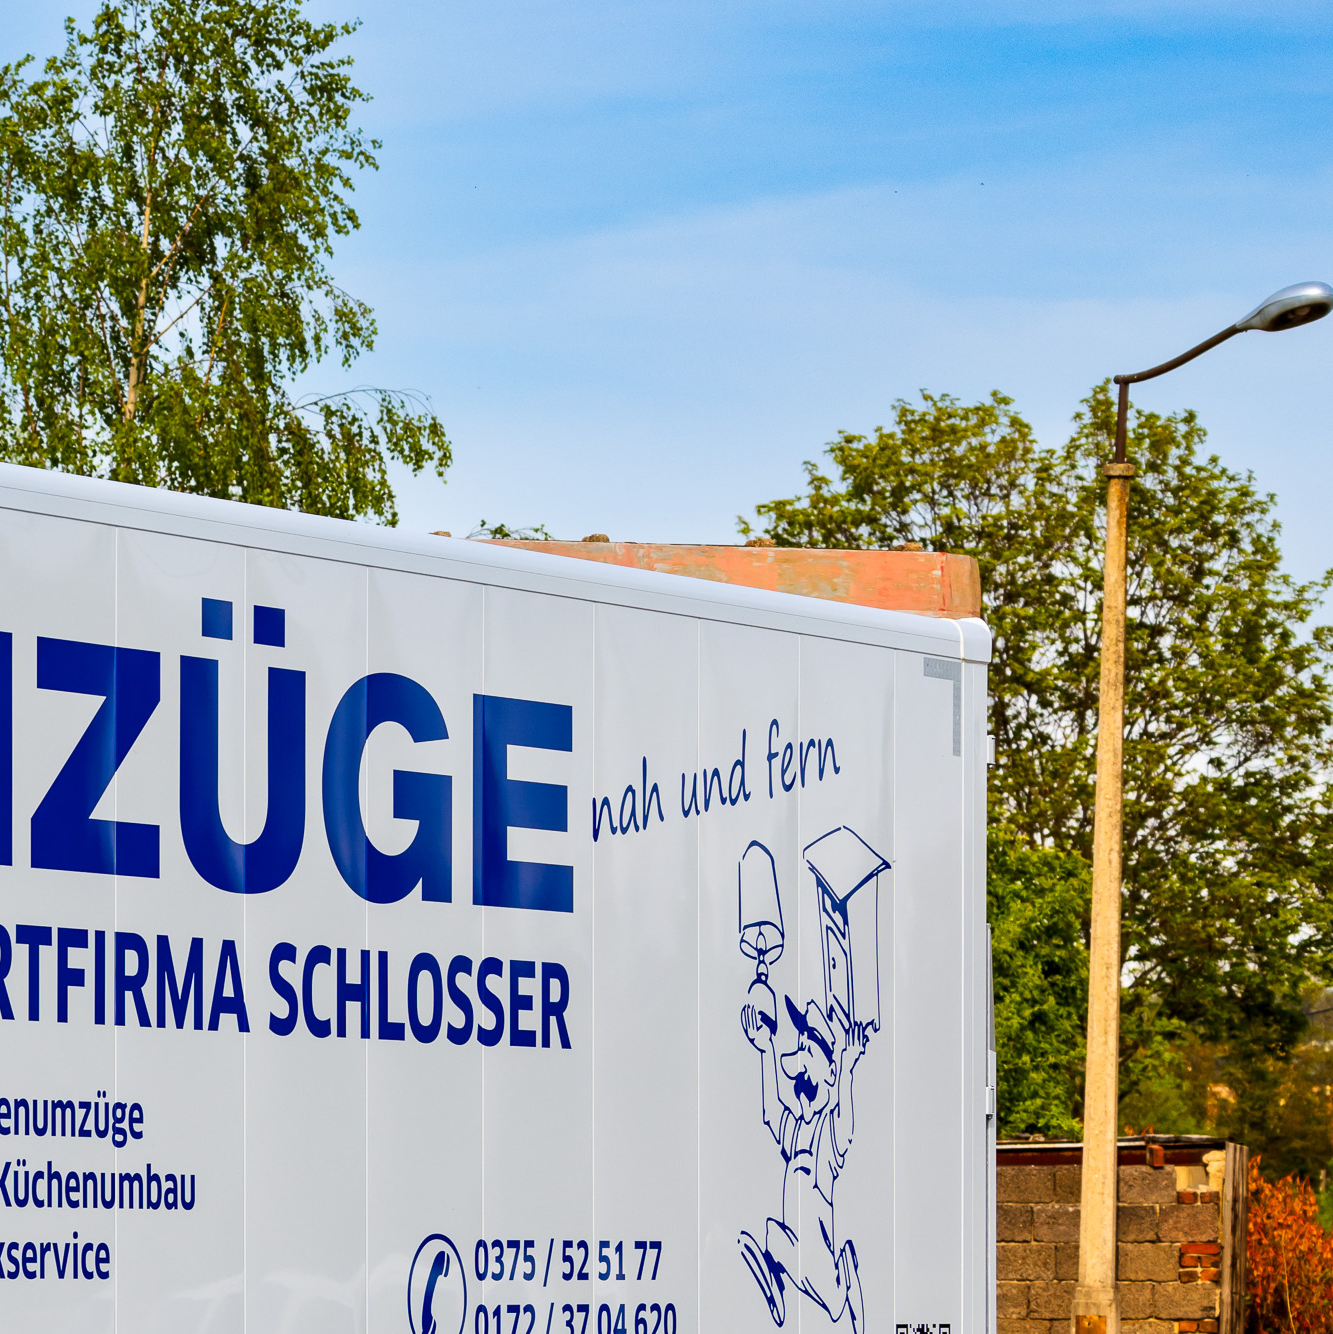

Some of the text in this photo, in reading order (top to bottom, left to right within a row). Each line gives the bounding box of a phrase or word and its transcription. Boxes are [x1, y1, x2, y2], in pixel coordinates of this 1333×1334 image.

[592, 718, 841, 843] nah und fern
[268, 941, 572, 1050] SCHLOSSER
[474, 1237, 662, 1288] 0375 / 52 51 77
